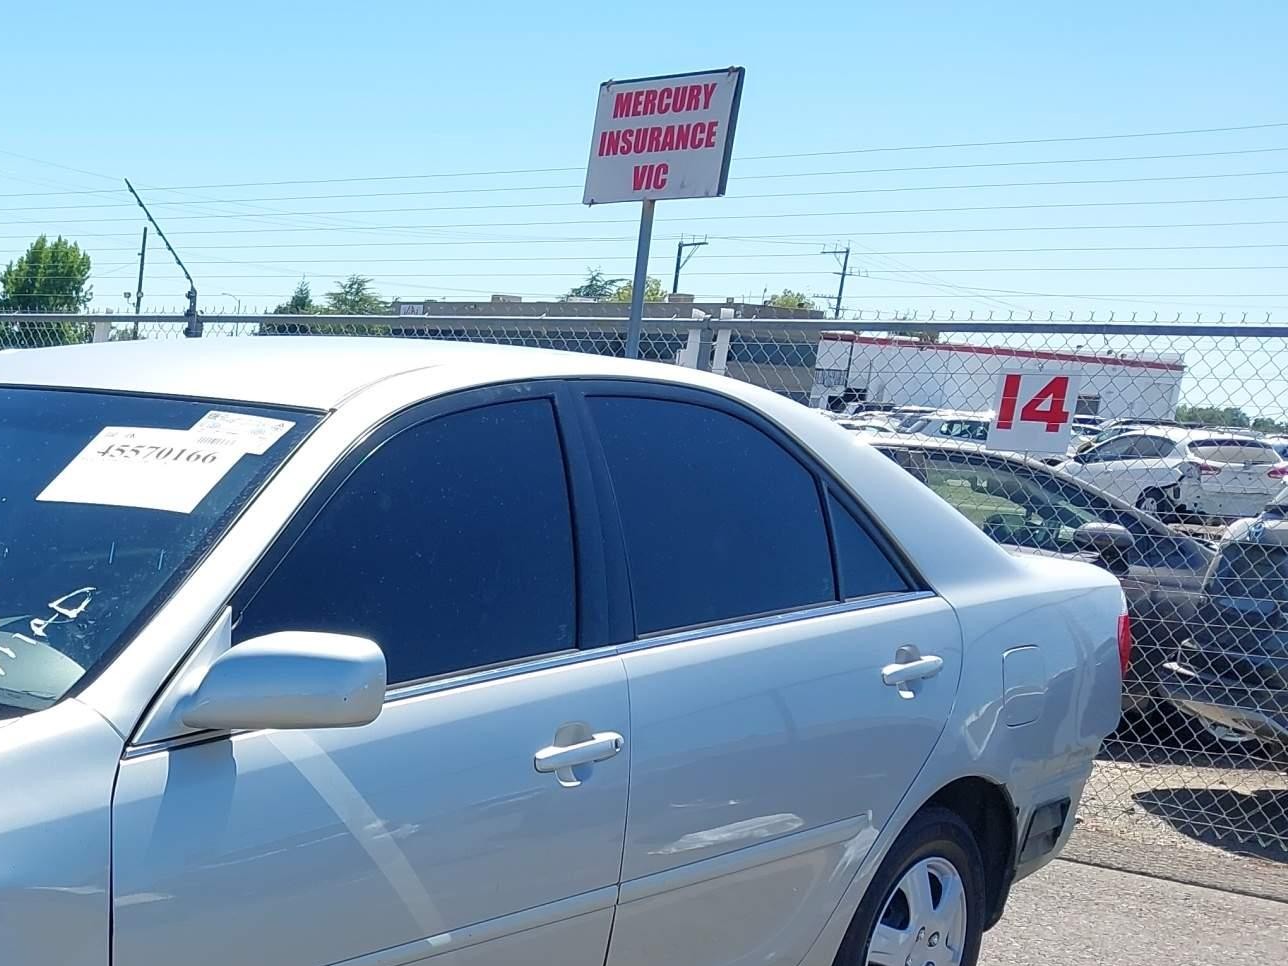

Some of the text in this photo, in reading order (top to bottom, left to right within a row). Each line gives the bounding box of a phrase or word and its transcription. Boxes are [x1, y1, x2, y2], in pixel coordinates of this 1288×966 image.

[613, 83, 717, 118] MERCURY
[598, 121, 719, 157] INSURANCE
[632, 163, 669, 191] VIC
[996, 374, 1069, 433] 14
[97, 444, 219, 464] 45570166
